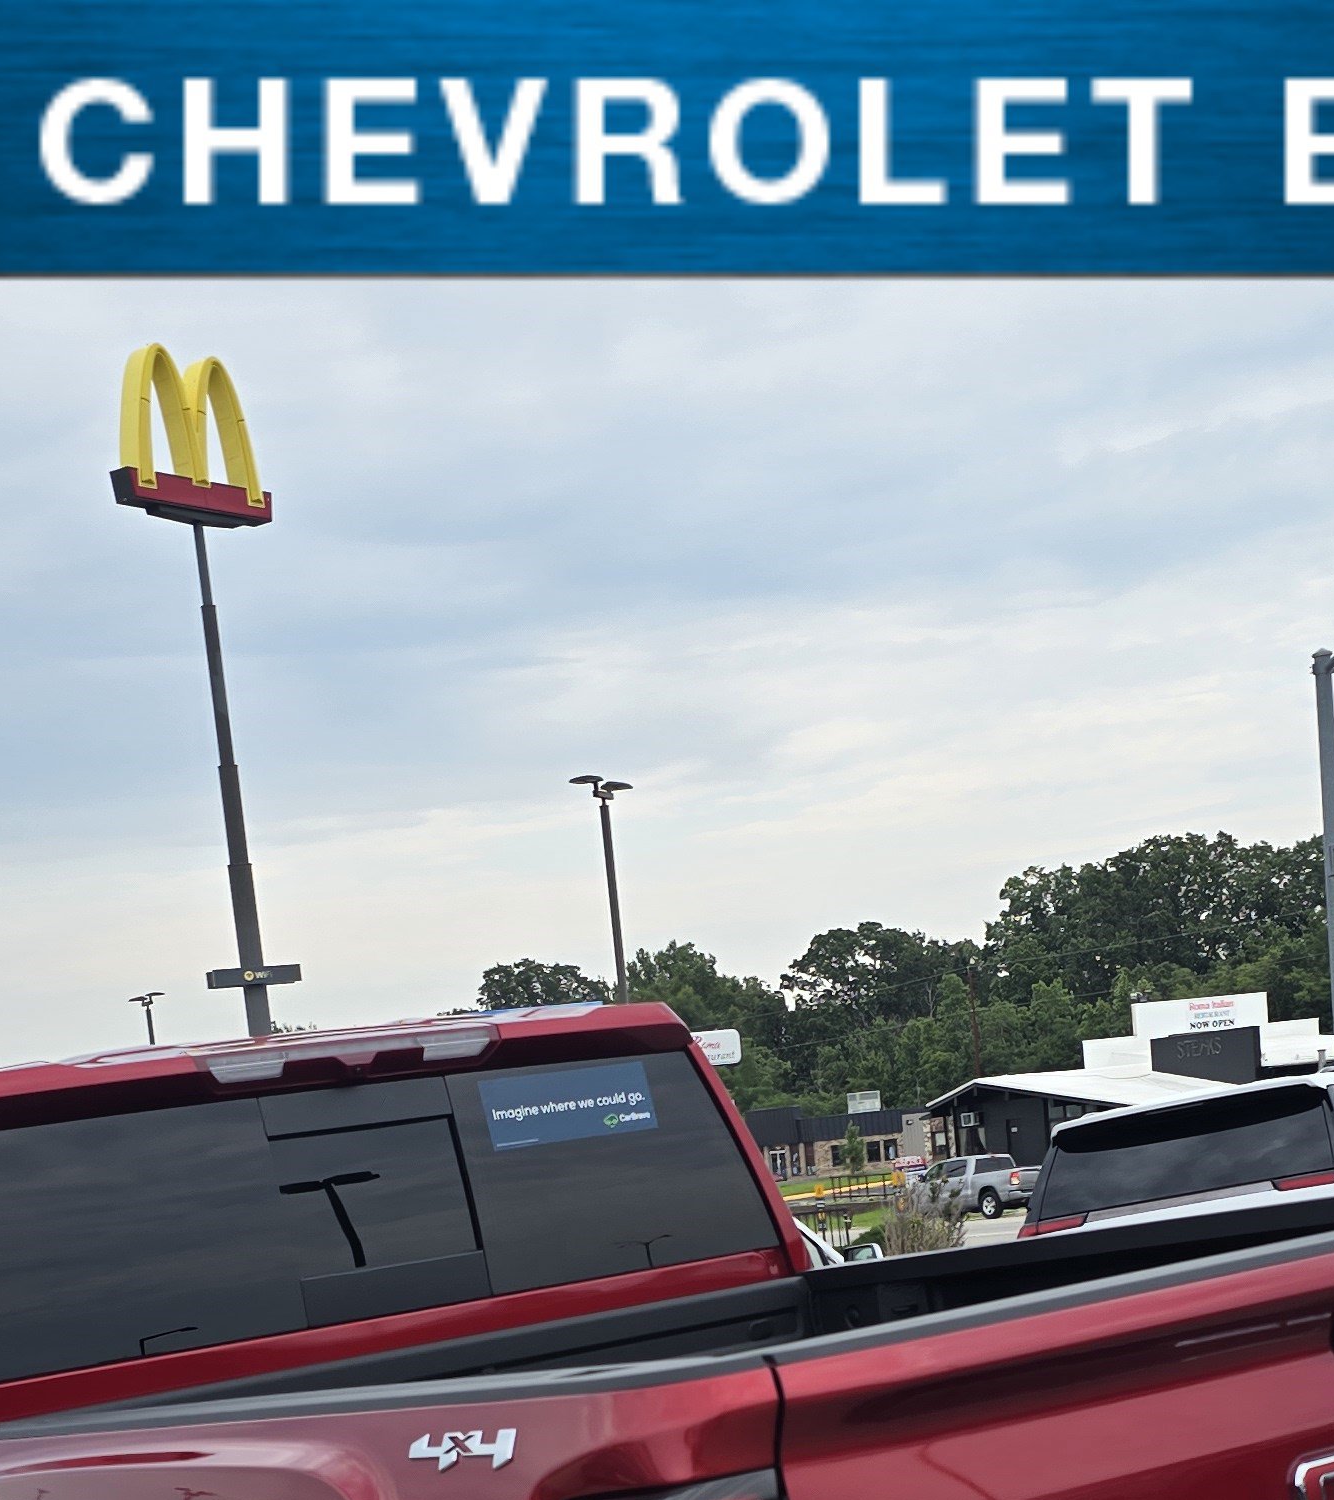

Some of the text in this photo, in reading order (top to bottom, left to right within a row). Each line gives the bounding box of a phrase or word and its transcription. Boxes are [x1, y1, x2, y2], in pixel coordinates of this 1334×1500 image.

[1190, 1018, 1236, 1031] NOW OPEN
[492, 1091, 646, 1122] Imagine where we could go.
